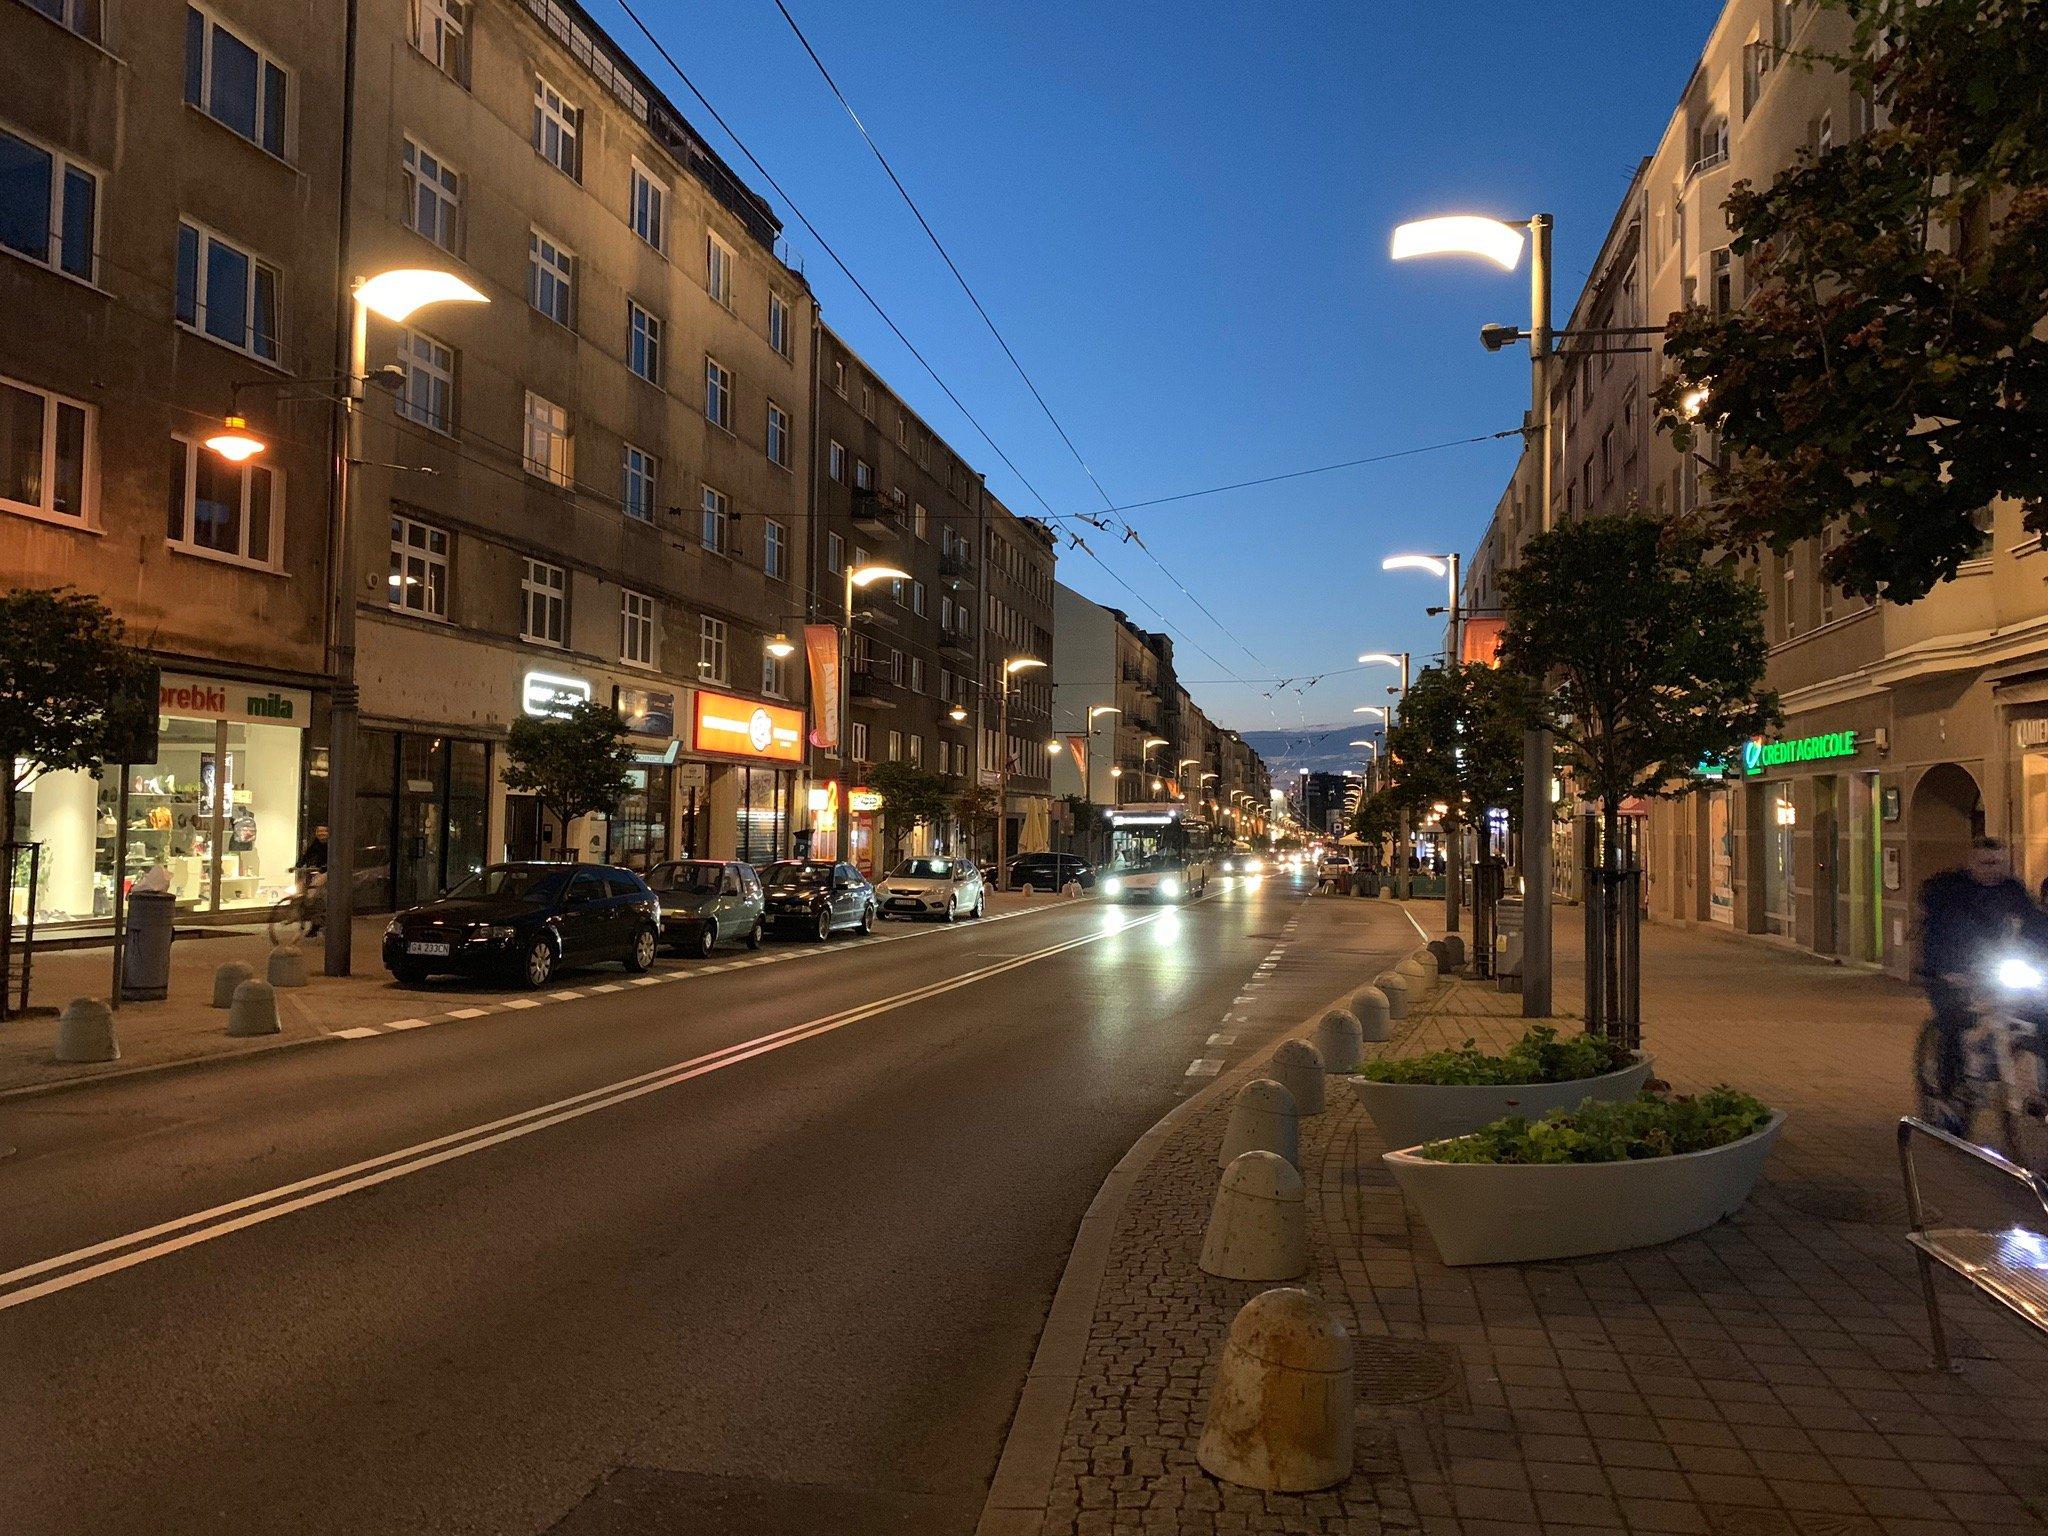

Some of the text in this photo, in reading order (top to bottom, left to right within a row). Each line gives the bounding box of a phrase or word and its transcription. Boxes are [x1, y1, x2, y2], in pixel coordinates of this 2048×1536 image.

[247, 692, 294, 719] mila
[1796, 730, 1856, 762] AGRICOLE
[1333, 823, 1342, 834] P
